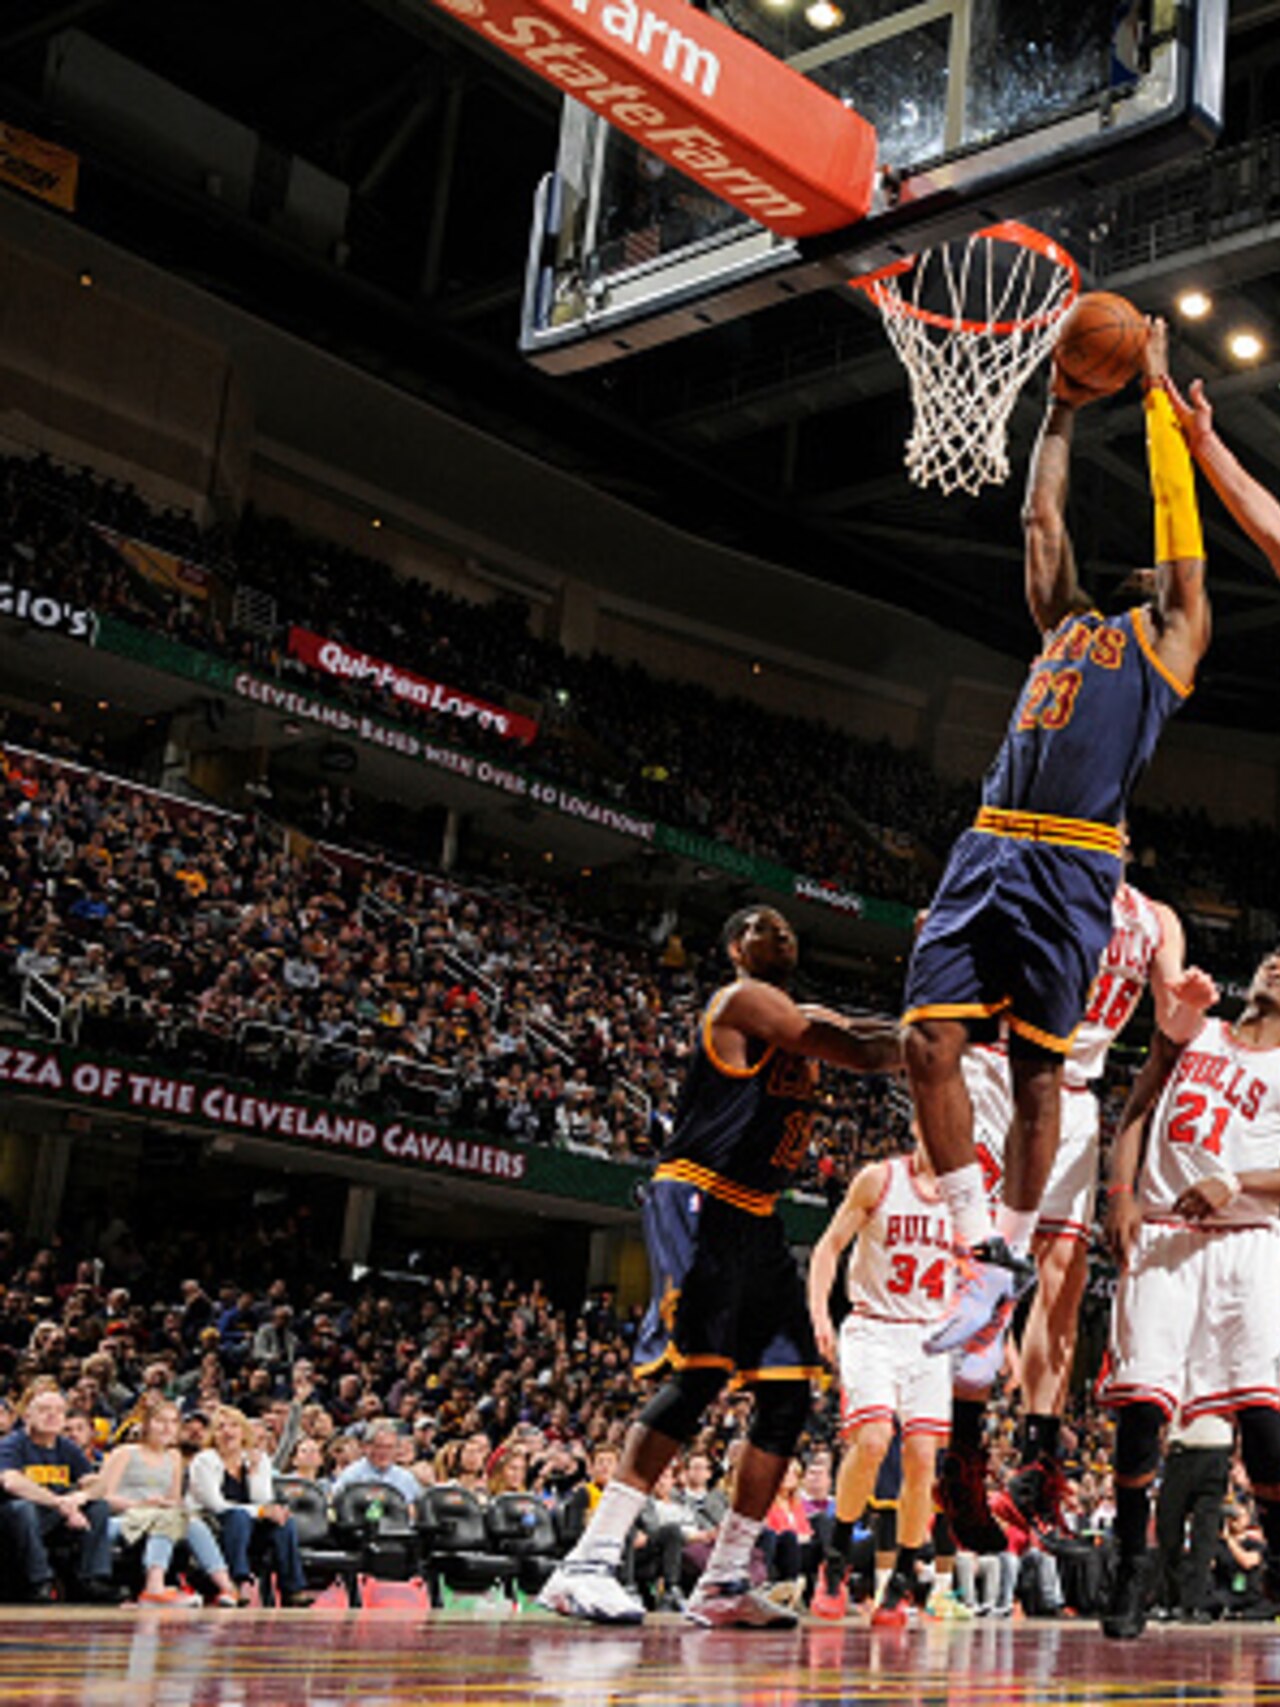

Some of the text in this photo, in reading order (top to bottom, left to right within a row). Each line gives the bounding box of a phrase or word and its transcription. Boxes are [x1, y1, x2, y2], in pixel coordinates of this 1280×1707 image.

[566, 0, 722, 97] arm
[482, 14, 807, 219] State Farm
[1016, 667, 1083, 731] 23
[1086, 972, 1139, 1031] 16
[1166, 1048, 1269, 1121] BULLS
[72, 1064, 121, 1097] OF
[128, 1073, 195, 1114] THE
[202, 1086, 376, 1147] CLEVELAND
[382, 1123, 527, 1179] CAVALIERS
[1167, 1091, 1231, 1156] 21
[884, 1214, 950, 1250] BULL
[886, 1253, 946, 1300] 34
